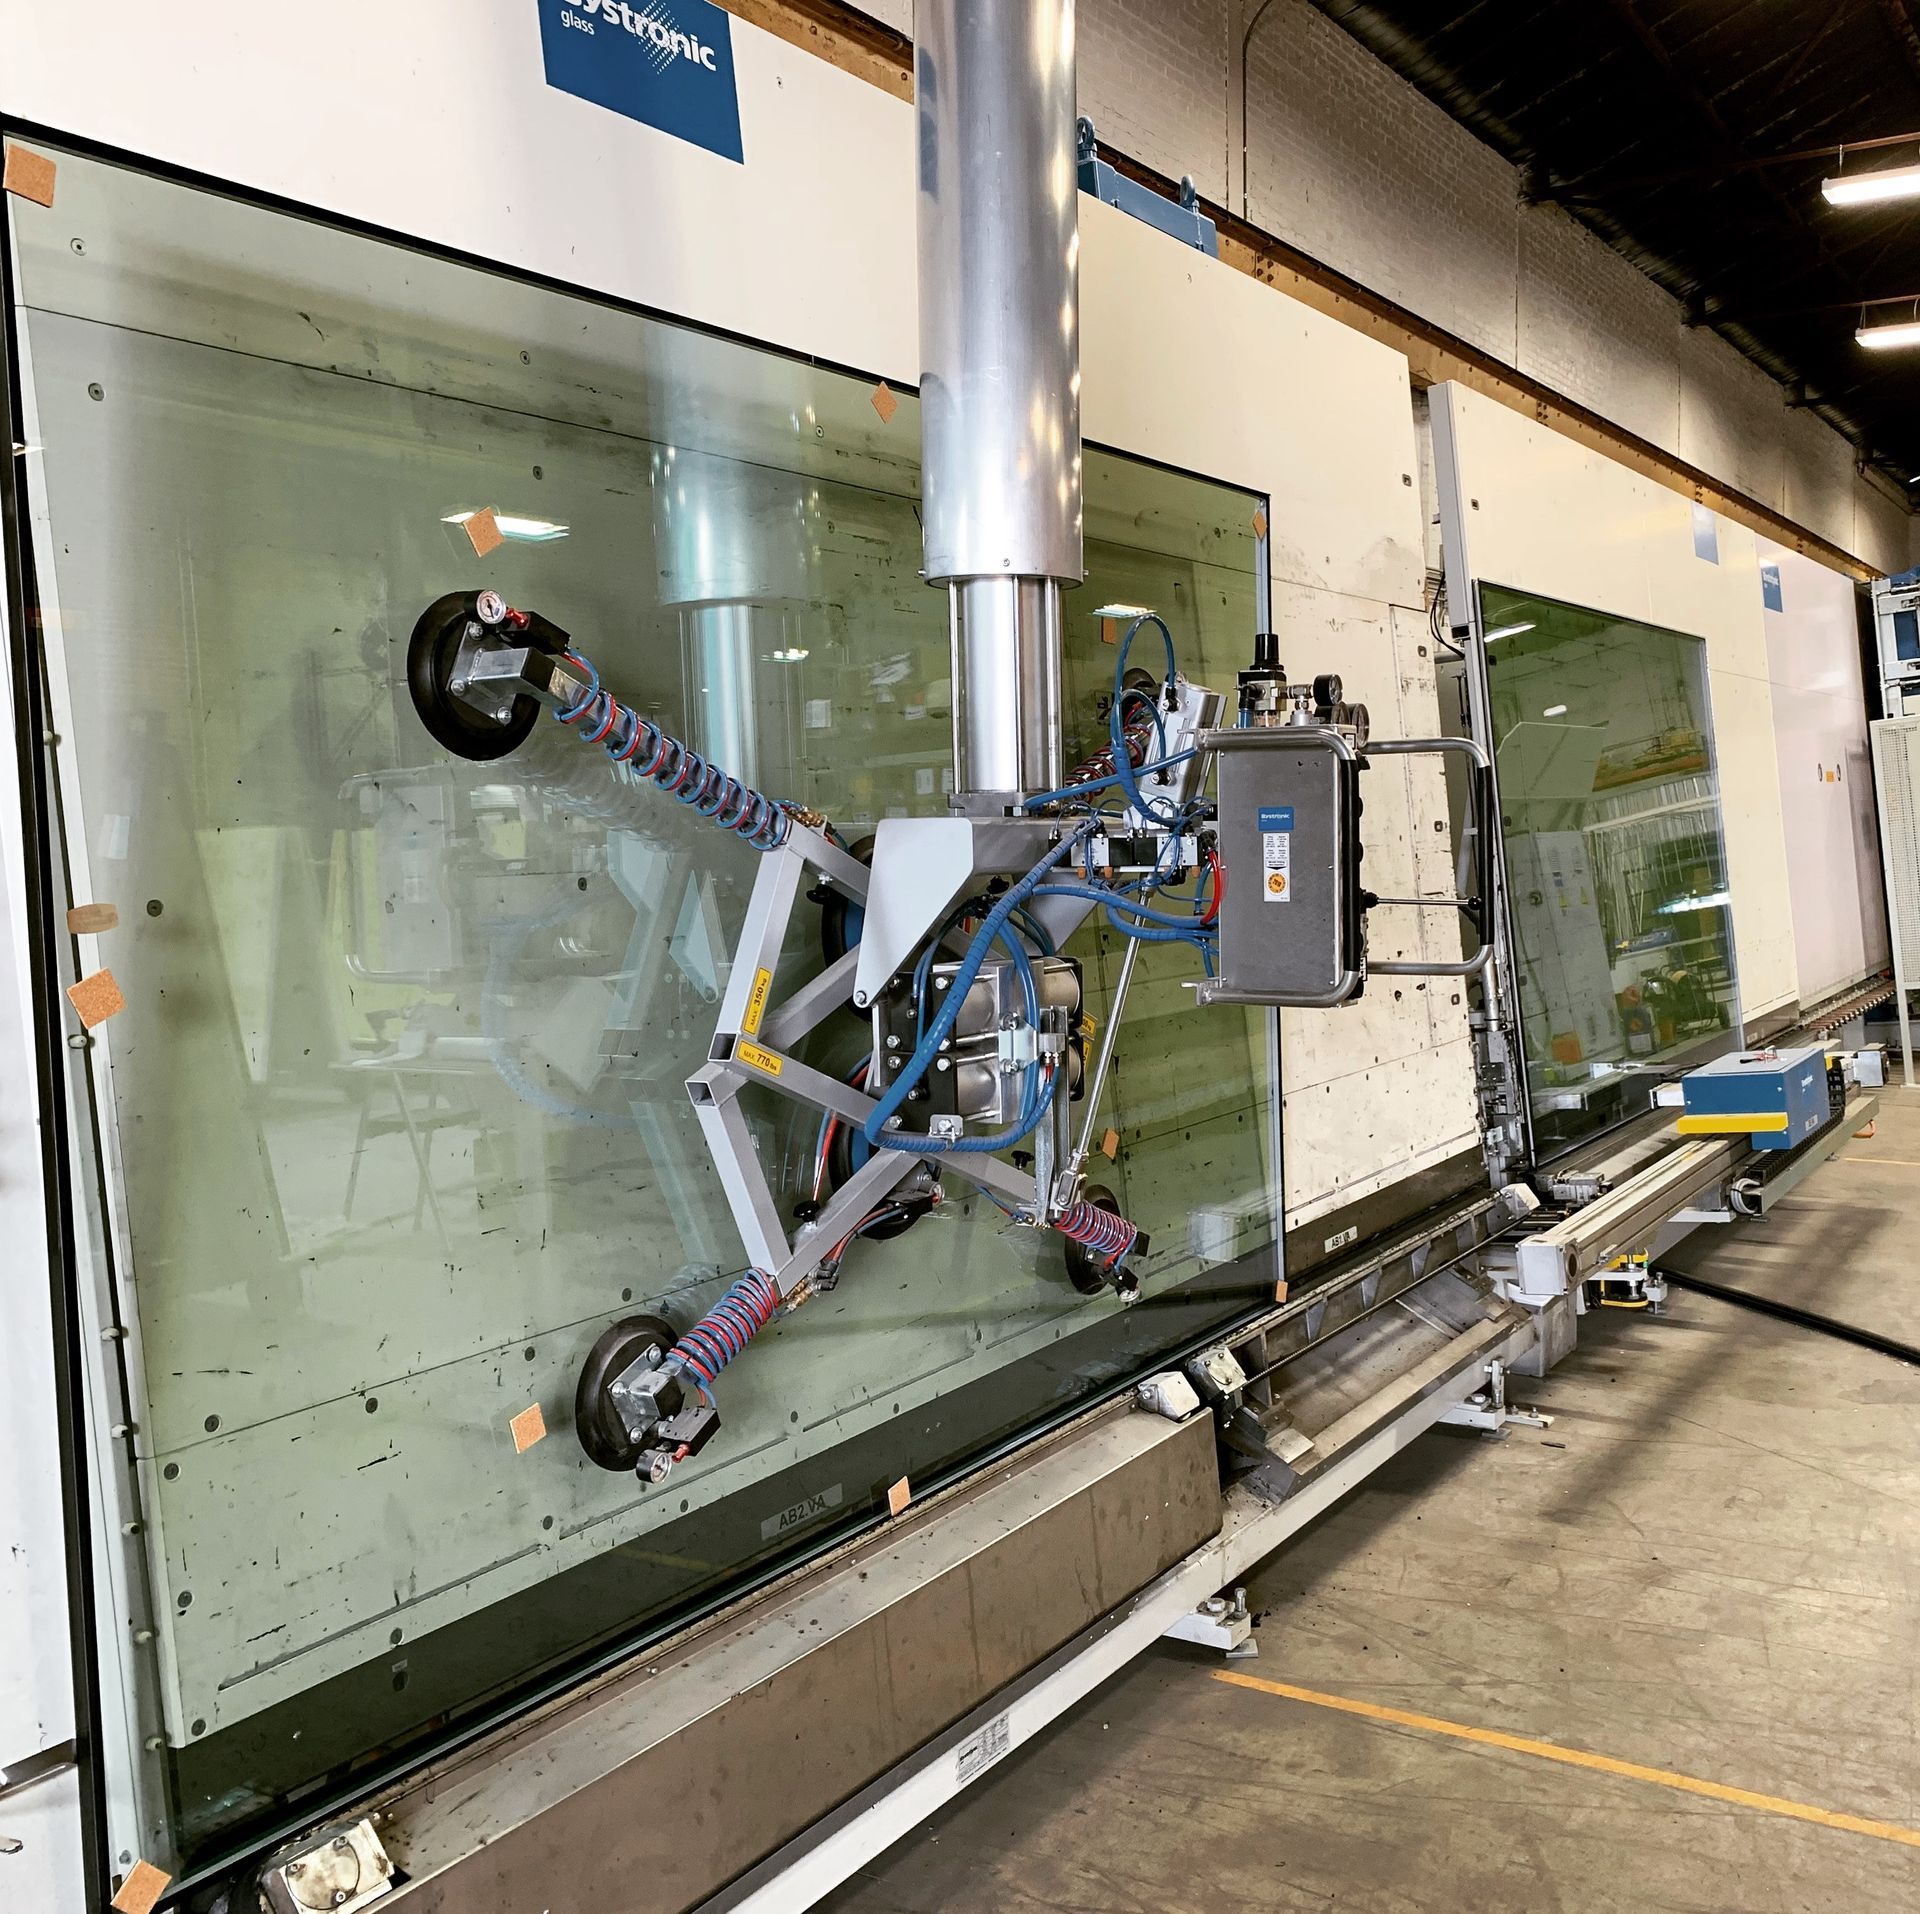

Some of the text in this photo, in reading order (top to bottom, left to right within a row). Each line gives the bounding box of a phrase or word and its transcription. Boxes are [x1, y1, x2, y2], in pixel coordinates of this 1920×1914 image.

[561, 9, 595, 36] glass
[565, 0, 717, 71] ystronic
[754, 987, 763, 1006] 350
[757, 1053, 771, 1067] 770
